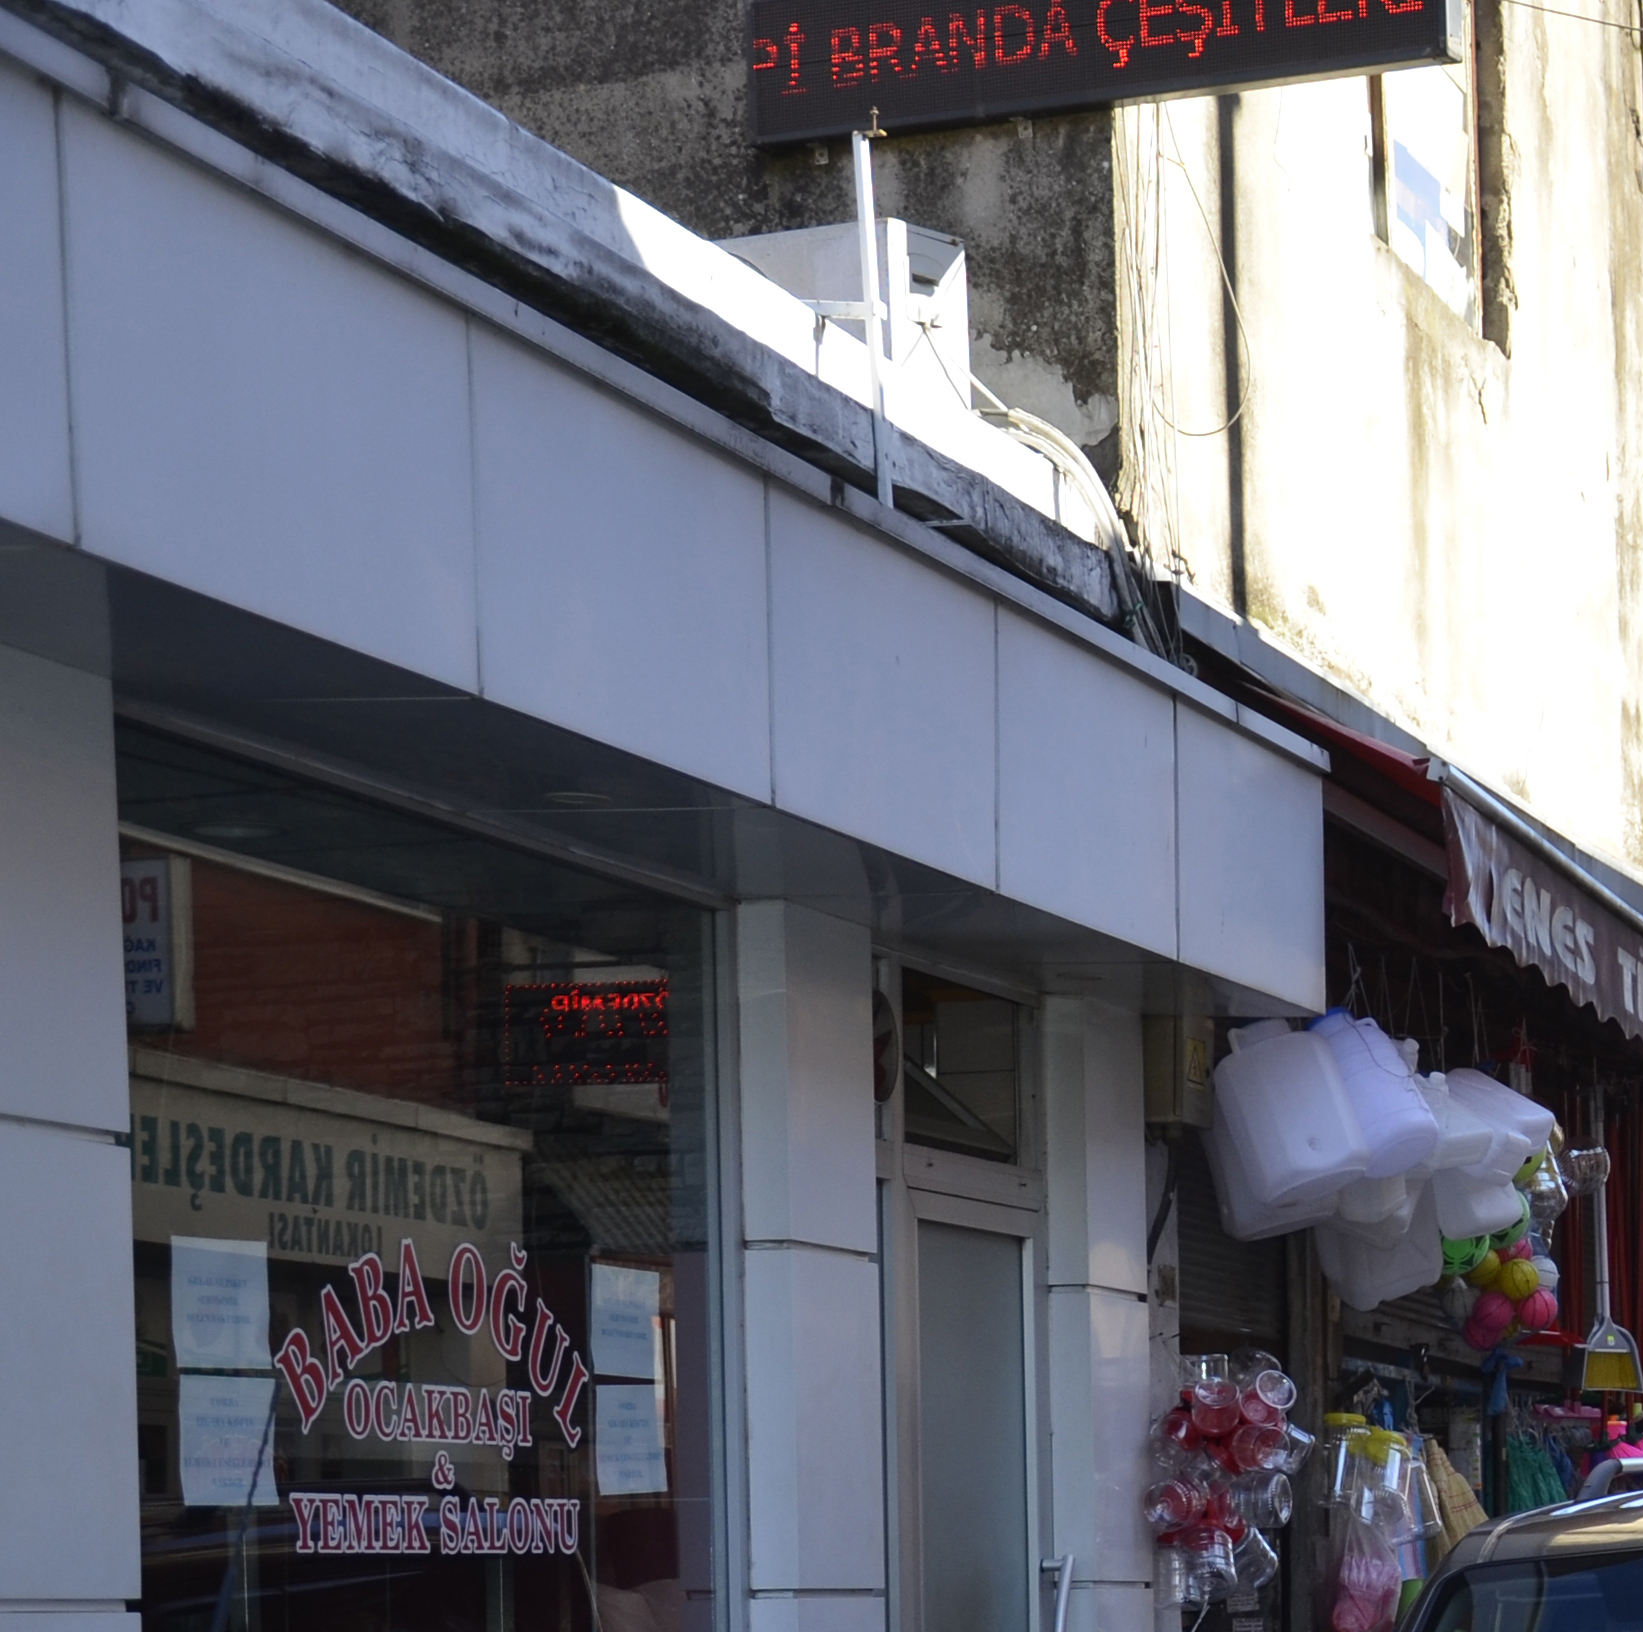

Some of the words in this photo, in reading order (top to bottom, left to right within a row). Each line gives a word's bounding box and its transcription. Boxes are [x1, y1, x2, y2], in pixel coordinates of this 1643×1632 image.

[830, 0, 1078, 87] BRANDA
[1097, 0, 1423, 68] ÇEŞİT
[1503, 868, 1596, 985] ENES
[275, 1238, 434, 1434] BABA
[449, 1241, 588, 1448] OĞUL
[344, 1378, 532, 1461] OCAKBAŞI
[432, 1450, 454, 1489] &
[290, 1492, 430, 1553] YEMEK
[440, 1496, 580, 1554] SALONU
